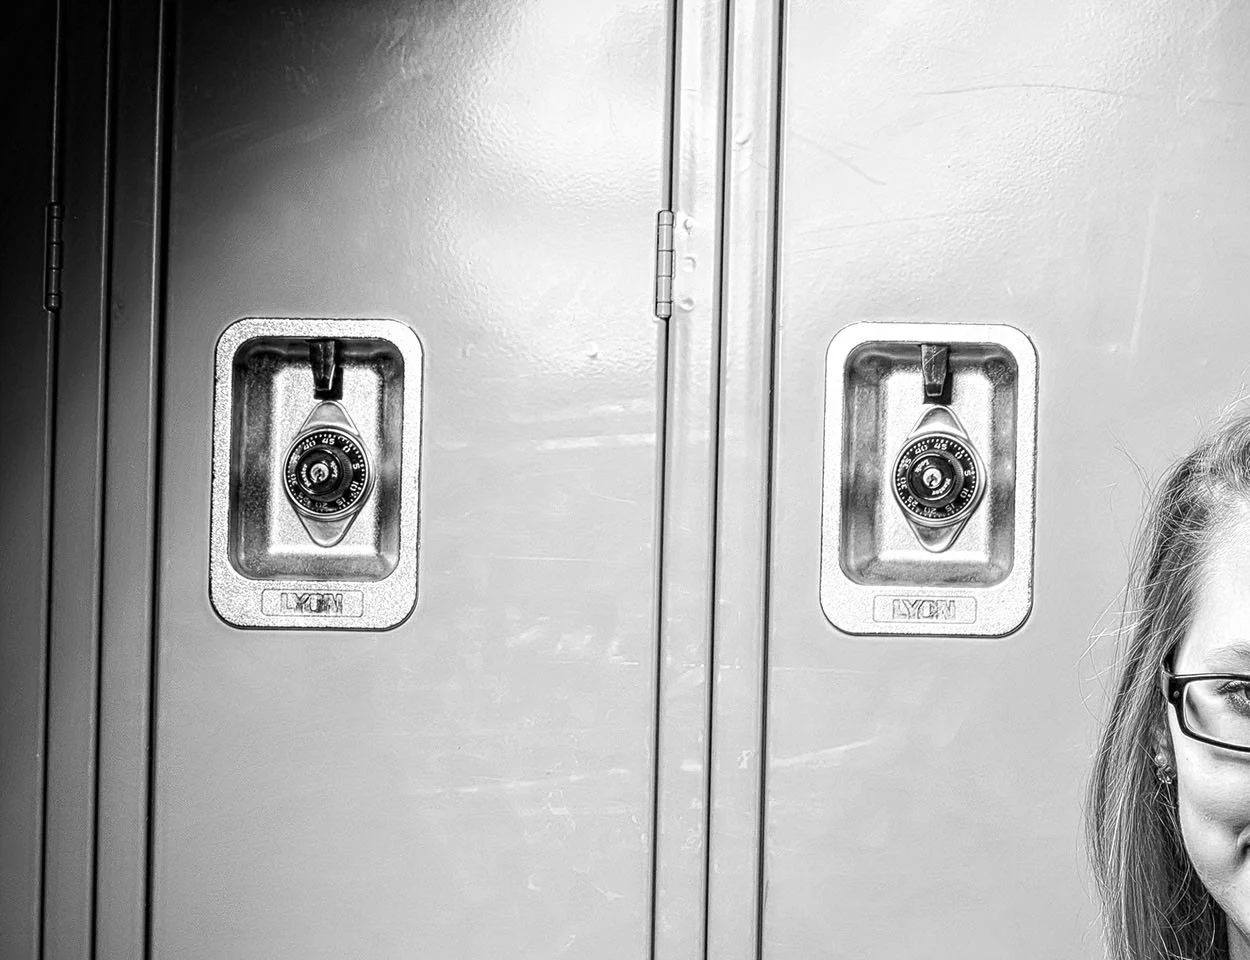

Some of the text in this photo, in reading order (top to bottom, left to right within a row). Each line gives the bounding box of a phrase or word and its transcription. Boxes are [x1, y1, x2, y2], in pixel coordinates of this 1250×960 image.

[303, 440, 316, 450] 40
[915, 444, 928, 454] 40
[933, 443, 947, 451] 45
[281, 593, 343, 613] LYON
[892, 599, 956, 620] LYON
